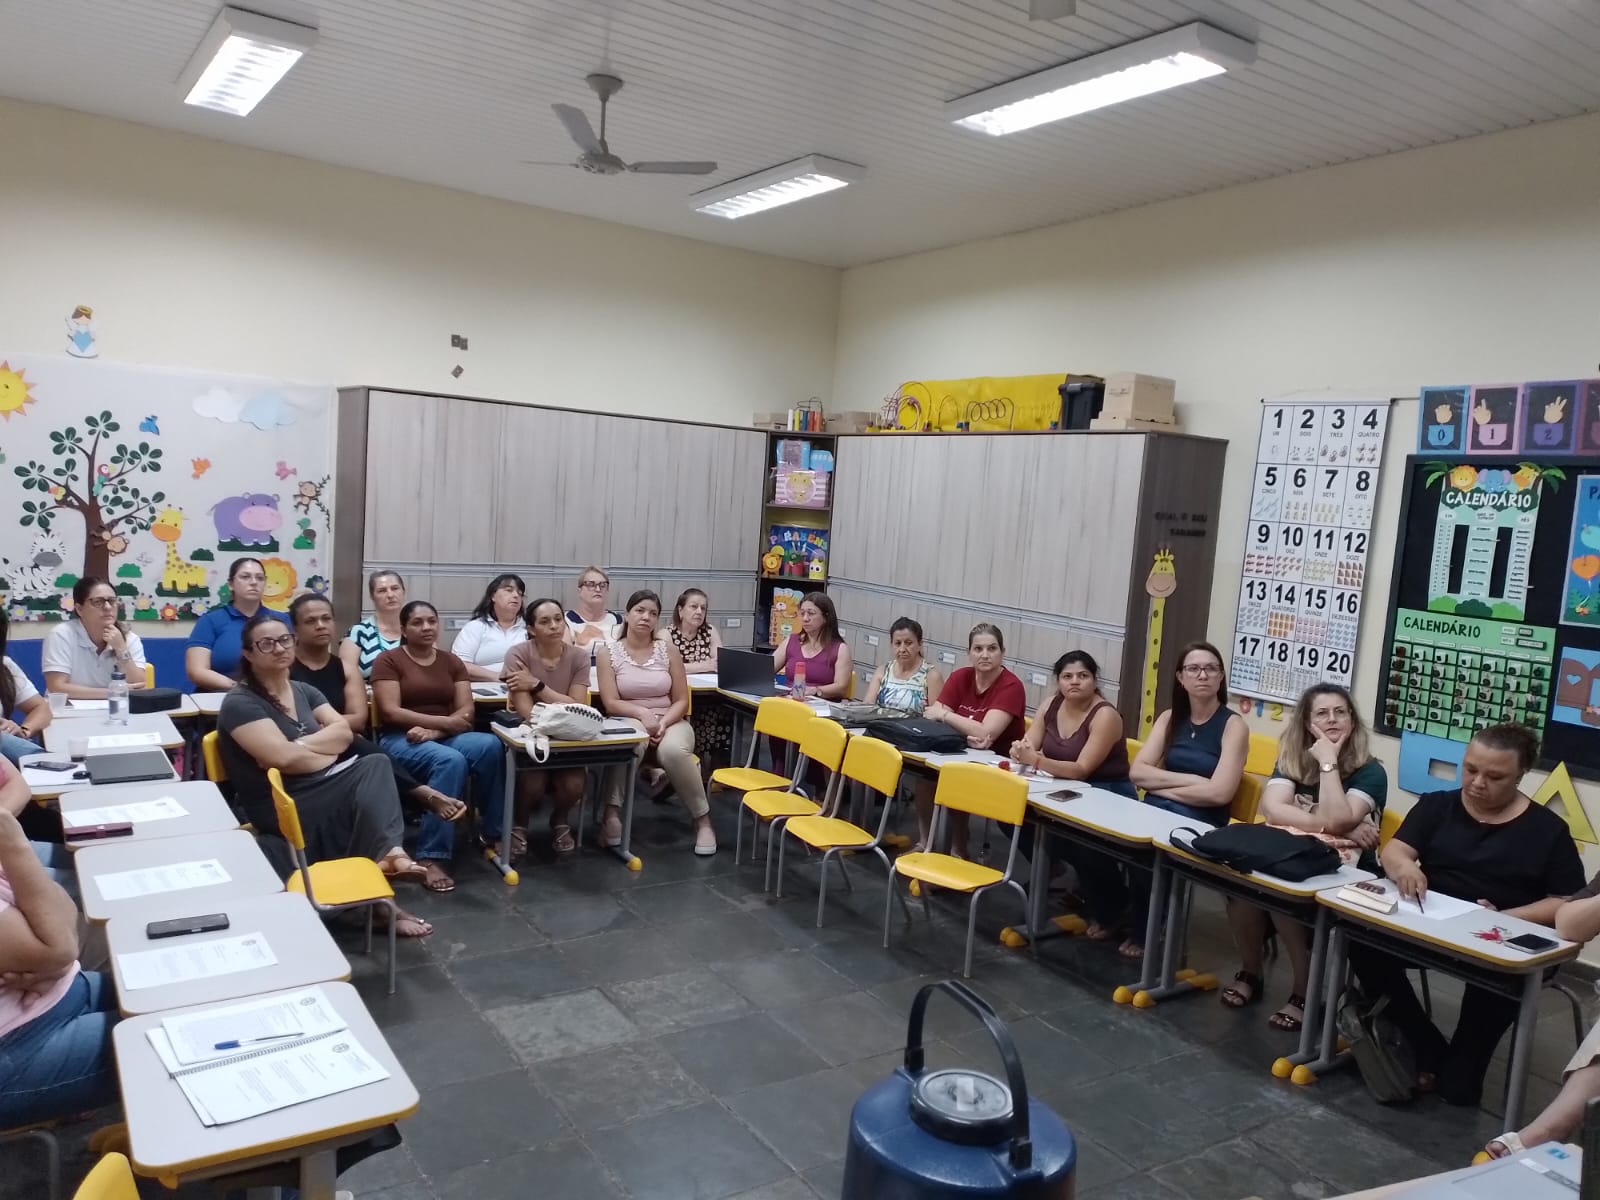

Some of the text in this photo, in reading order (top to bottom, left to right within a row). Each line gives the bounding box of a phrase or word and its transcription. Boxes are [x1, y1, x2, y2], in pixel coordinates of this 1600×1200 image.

[1273, 408, 1283, 429] 1
[1300, 408, 1315, 429] 2
[1331, 408, 1345, 430] 3
[1362, 408, 1378, 430] 4
[1437, 429, 1446, 441] 0
[1488, 429, 1495, 440] 1
[1544, 429, 1553, 440] 2
[1264, 466, 1278, 486] 5
[1293, 467, 1307, 488] 6
[1325, 469, 1339, 489] 7
[1355, 470, 1371, 491] 8
[1445, 491, 1532, 508] CALENDÁRIO
[1257, 523, 1271, 544] 9
[1282, 526, 1304, 547] 10
[1313, 528, 1334, 551] 11
[1343, 531, 1367, 554] 12
[1246, 579, 1267, 601] 13
[1274, 583, 1296, 606] 14
[1304, 587, 1327, 610] 15
[1304, 609, 1323, 617] QUINZE
[1335, 591, 1359, 615] 16
[1403, 616, 1481, 639] CALENDÁRIO
[1239, 635, 1260, 657] 17
[1268, 640, 1289, 663] 18
[1297, 645, 1319, 668] 19
[1326, 651, 1351, 675] 20
